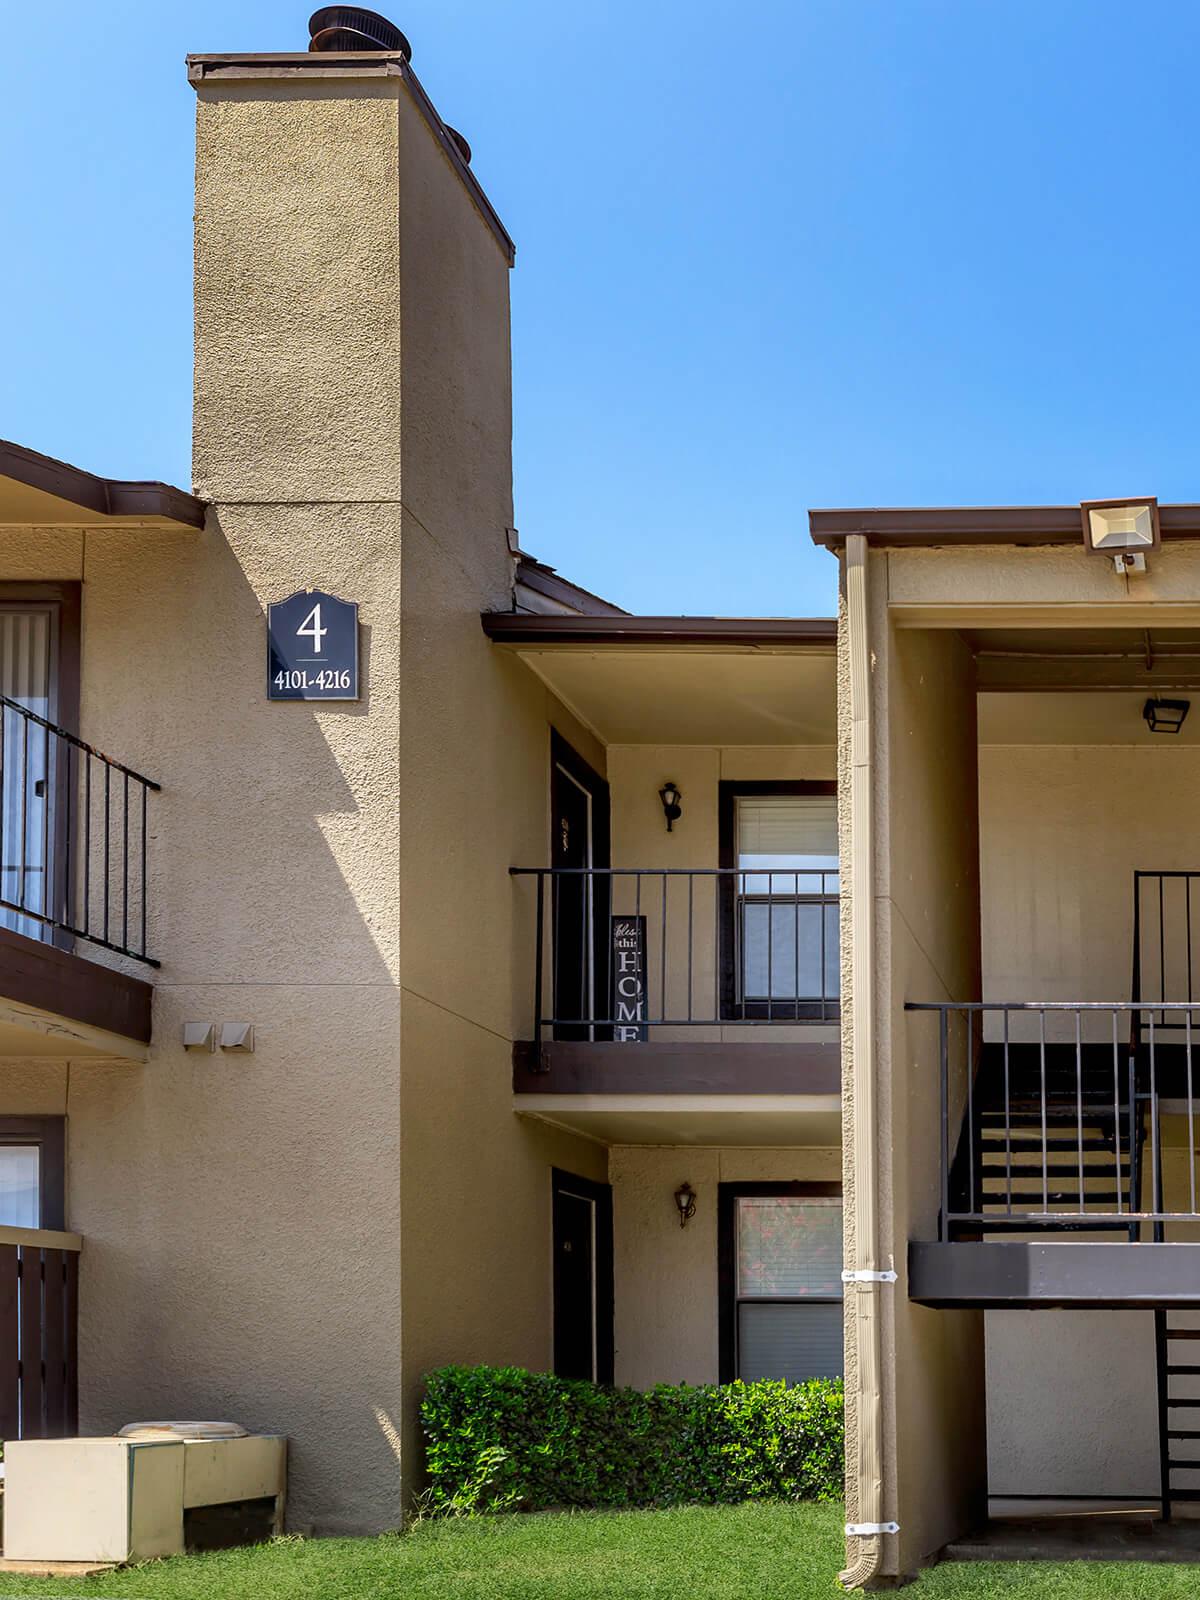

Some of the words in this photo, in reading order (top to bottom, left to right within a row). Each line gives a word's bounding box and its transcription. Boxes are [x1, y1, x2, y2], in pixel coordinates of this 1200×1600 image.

[296, 603, 327, 653] 4
[274, 669, 350, 690] 4101-4216
[615, 923, 641, 938] bles
